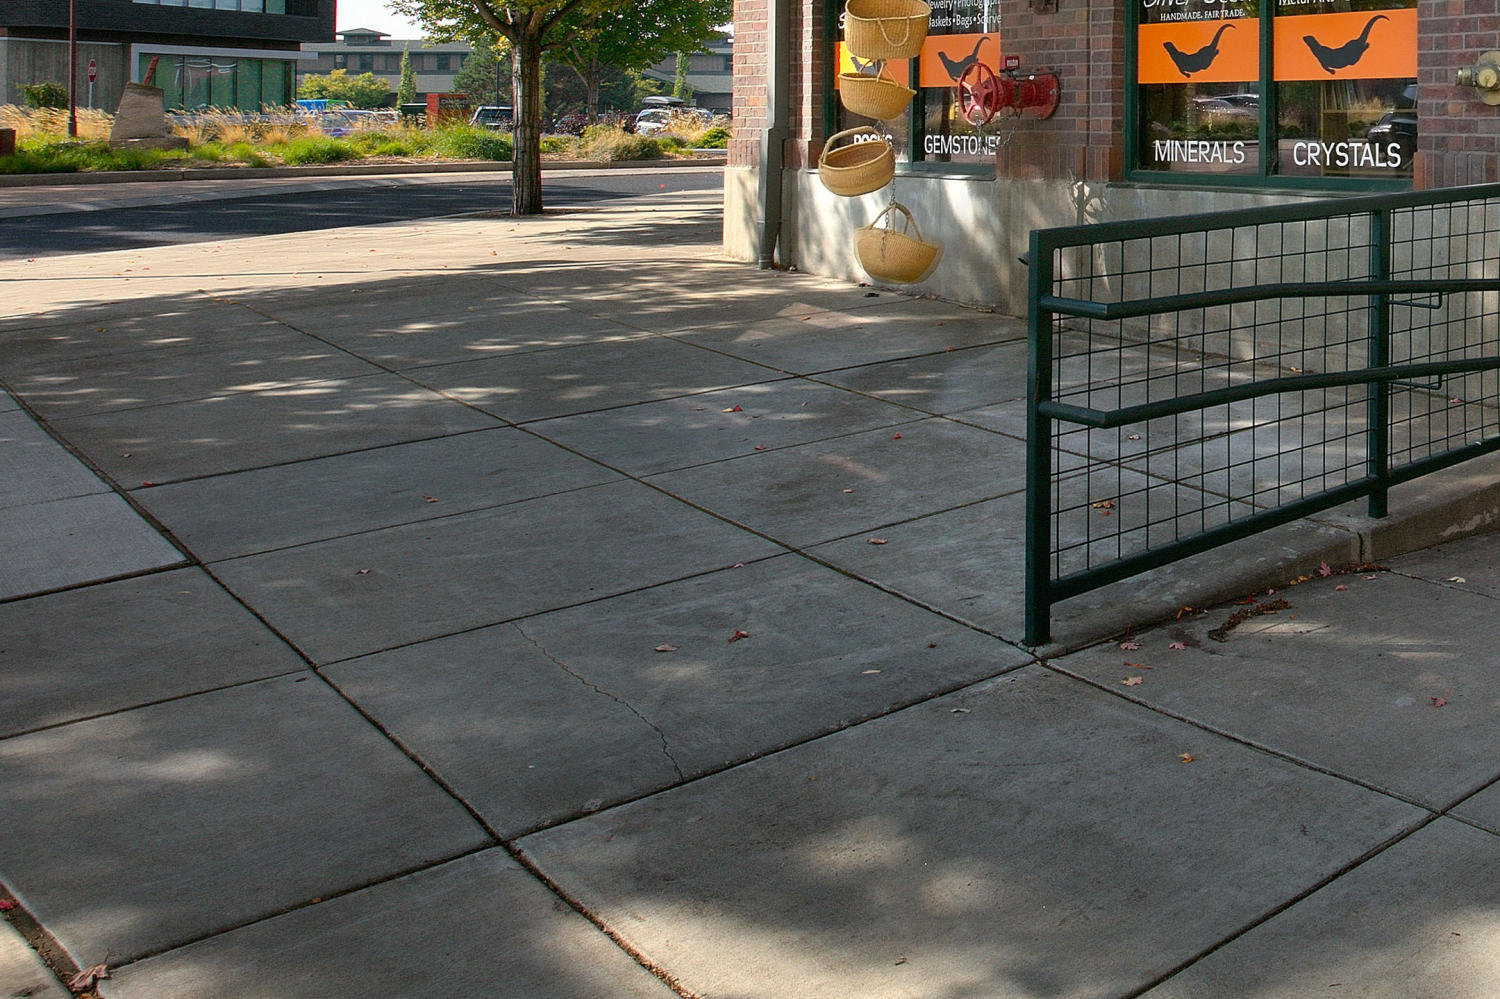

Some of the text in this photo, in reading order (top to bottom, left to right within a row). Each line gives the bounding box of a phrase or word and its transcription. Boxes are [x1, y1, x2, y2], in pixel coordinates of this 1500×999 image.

[956, 13, 973, 29] Bags
[1204, 9, 1220, 19] FAIR
[1154, 139, 1245, 165] MINERALS
[1293, 142, 1402, 168] CRYSTALS
